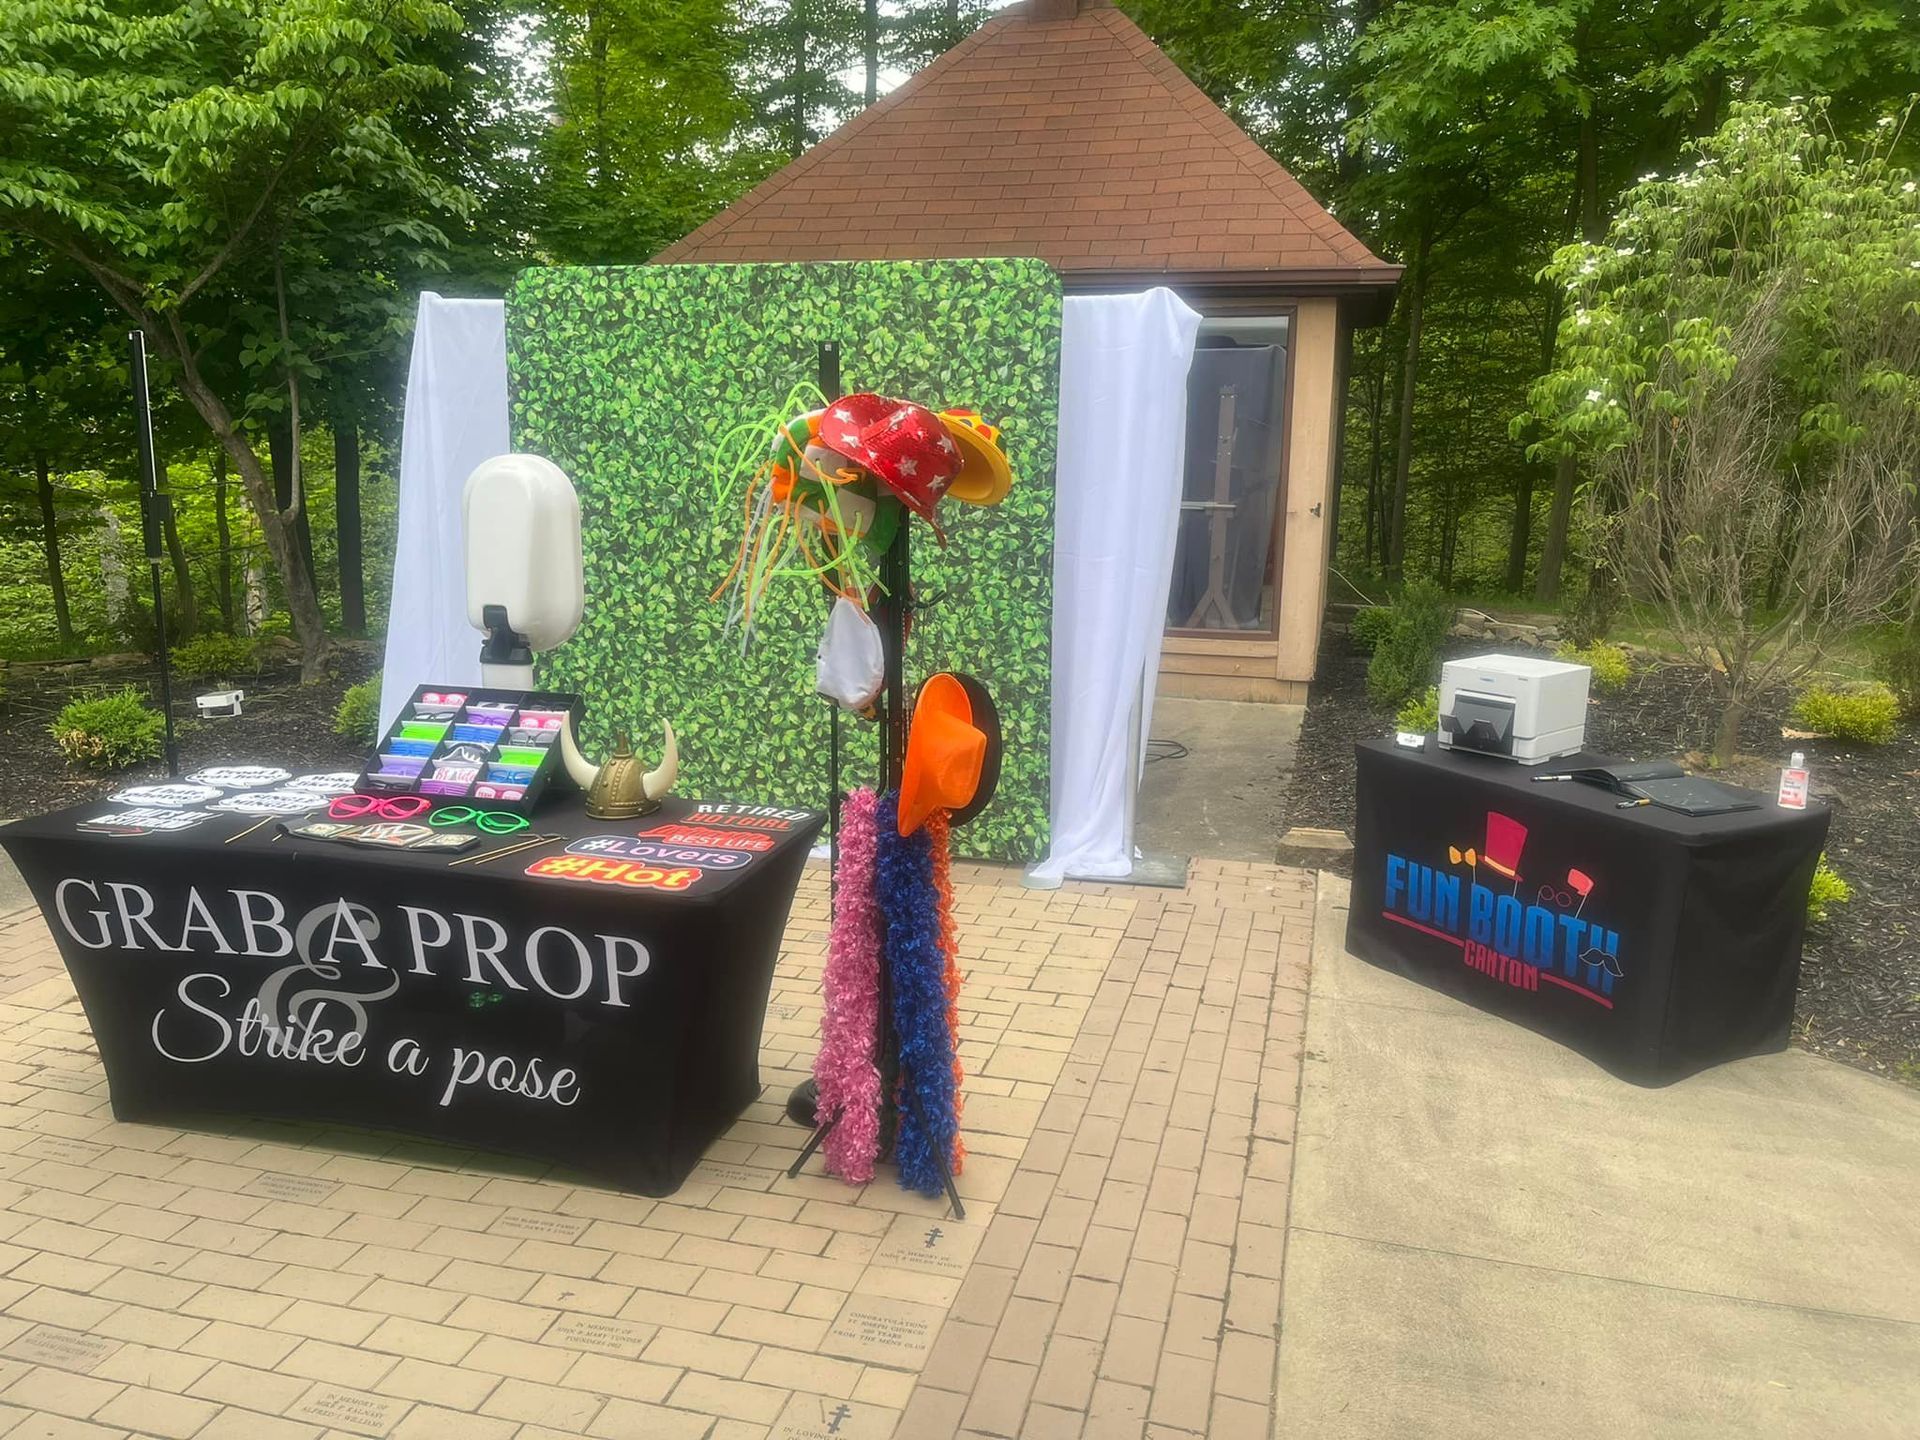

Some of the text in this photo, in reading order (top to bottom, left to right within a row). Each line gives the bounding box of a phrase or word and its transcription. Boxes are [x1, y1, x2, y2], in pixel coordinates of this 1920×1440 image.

[697, 803, 811, 822] RETIRED
[581, 837, 740, 865] #Lovers
[668, 834, 769, 850] BEST LIFE
[539, 857, 692, 887] #Hot
[55, 877, 651, 1008] GRAB A PROP
[1385, 853, 1620, 996] FUN BOOTH
[1463, 939, 1542, 992] CANTON
[151, 973, 581, 1107] Strike a pose
